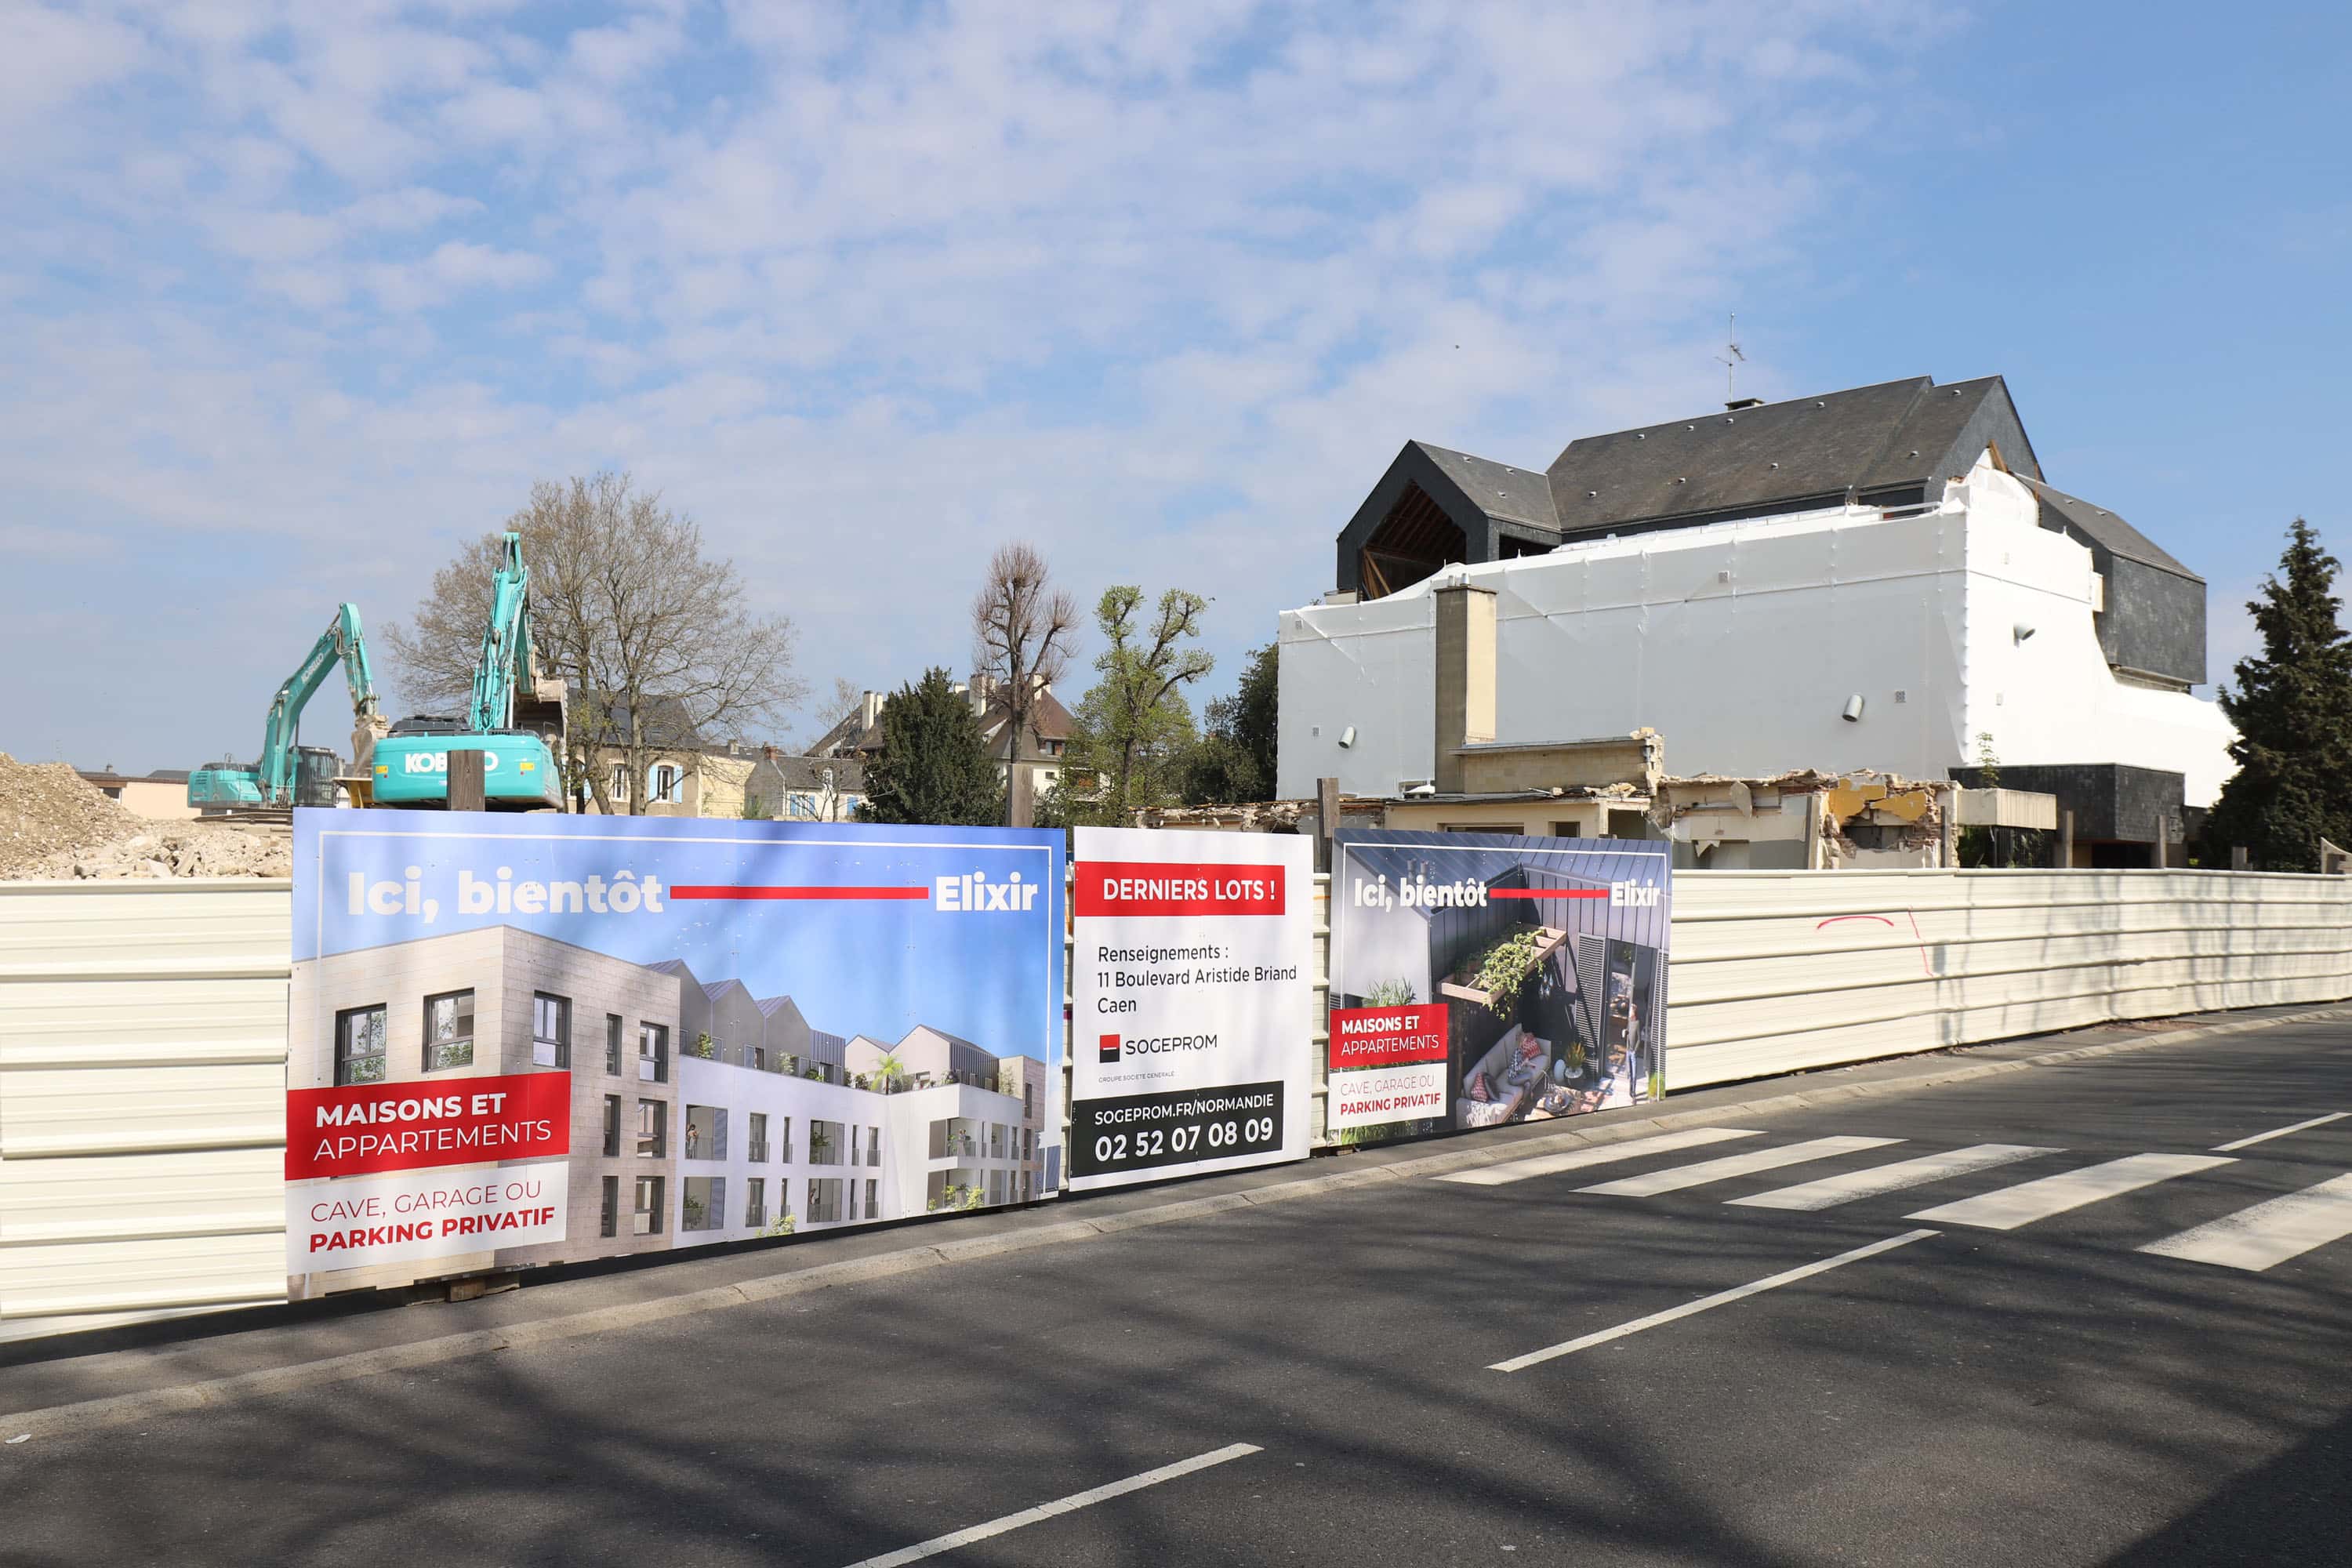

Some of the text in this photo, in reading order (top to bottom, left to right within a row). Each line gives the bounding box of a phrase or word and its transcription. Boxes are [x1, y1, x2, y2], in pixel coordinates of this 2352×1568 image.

[405, 752, 499, 773] KOBO
[348, 866, 1038, 924] Ici, bientôt Elixir
[1103, 878, 1208, 900] DERNIERS
[1215, 880, 1265, 900] LOTS
[1354, 874, 1661, 912] Ici, bientôt Elixir
[1098, 944, 1221, 964] Renseignements
[1098, 965, 1297, 988] 11 Boulevard Aristide Briand
[1098, 997, 1137, 1014] Caen
[1341, 1015, 1420, 1034] MAISONS ET
[1125, 1034, 1218, 1054] SOGEPROM
[1341, 1035, 1439, 1056] APPARTEMENTS
[1341, 1074, 1435, 1097] CAVE, GARAGE OU
[316, 1093, 506, 1127] MAISONS ET
[1094, 1094, 1274, 1126] SOGEPROM.FR/NORMANDIE
[1340, 1094, 1441, 1116] PARKING PRIVATIF
[314, 1120, 552, 1160] APPARTEMENTS
[1094, 1117, 1273, 1162] 02 52 07 08 09
[311, 1180, 542, 1222] CAVE, GARAGE OU
[310, 1207, 555, 1253] PARKING PRIVATIF
